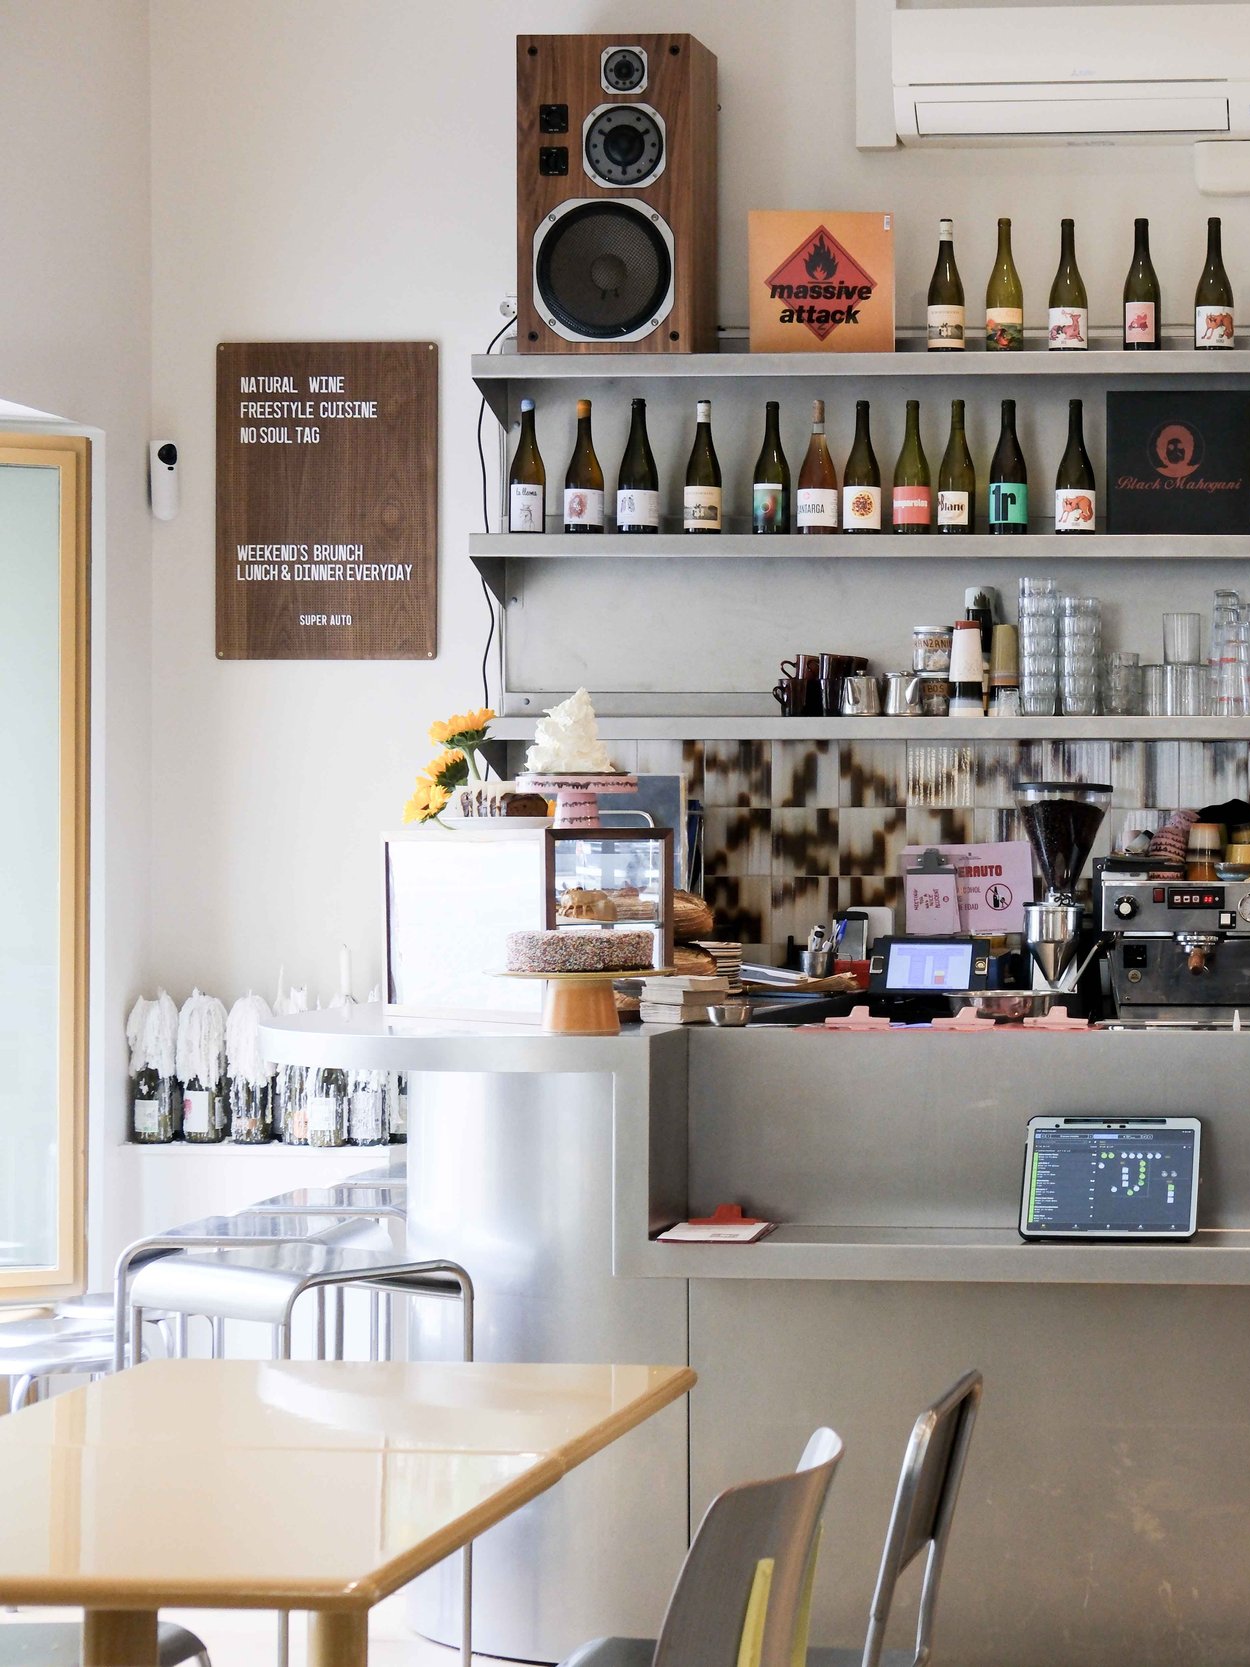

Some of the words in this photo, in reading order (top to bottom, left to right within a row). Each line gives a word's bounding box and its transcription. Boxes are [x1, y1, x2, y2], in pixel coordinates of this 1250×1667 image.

[770, 281, 872, 301] massive
[779, 304, 859, 325] attack
[240, 376, 298, 394] NATURAL
[309, 376, 345, 394] WINE
[240, 401, 314, 419] FREESTYLE
[320, 401, 378, 419] CUISINE
[240, 427, 257, 444] NO
[260, 427, 292, 444] SOUL
[295, 427, 320, 444] TAG
[1115, 476, 1160, 490] Black
[237, 544, 309, 562] WEEKEND'S
[313, 544, 363, 562] BRUNCH
[237, 564, 278, 581] LUNCH
[281, 564, 291, 581] &
[294, 564, 343, 581] DINNER
[346, 564, 412, 581] EVERYDAY
[300, 614, 327, 626] SUPER
[330, 614, 352, 626] AUTO
[957, 865, 1003, 878] ERAUTO
